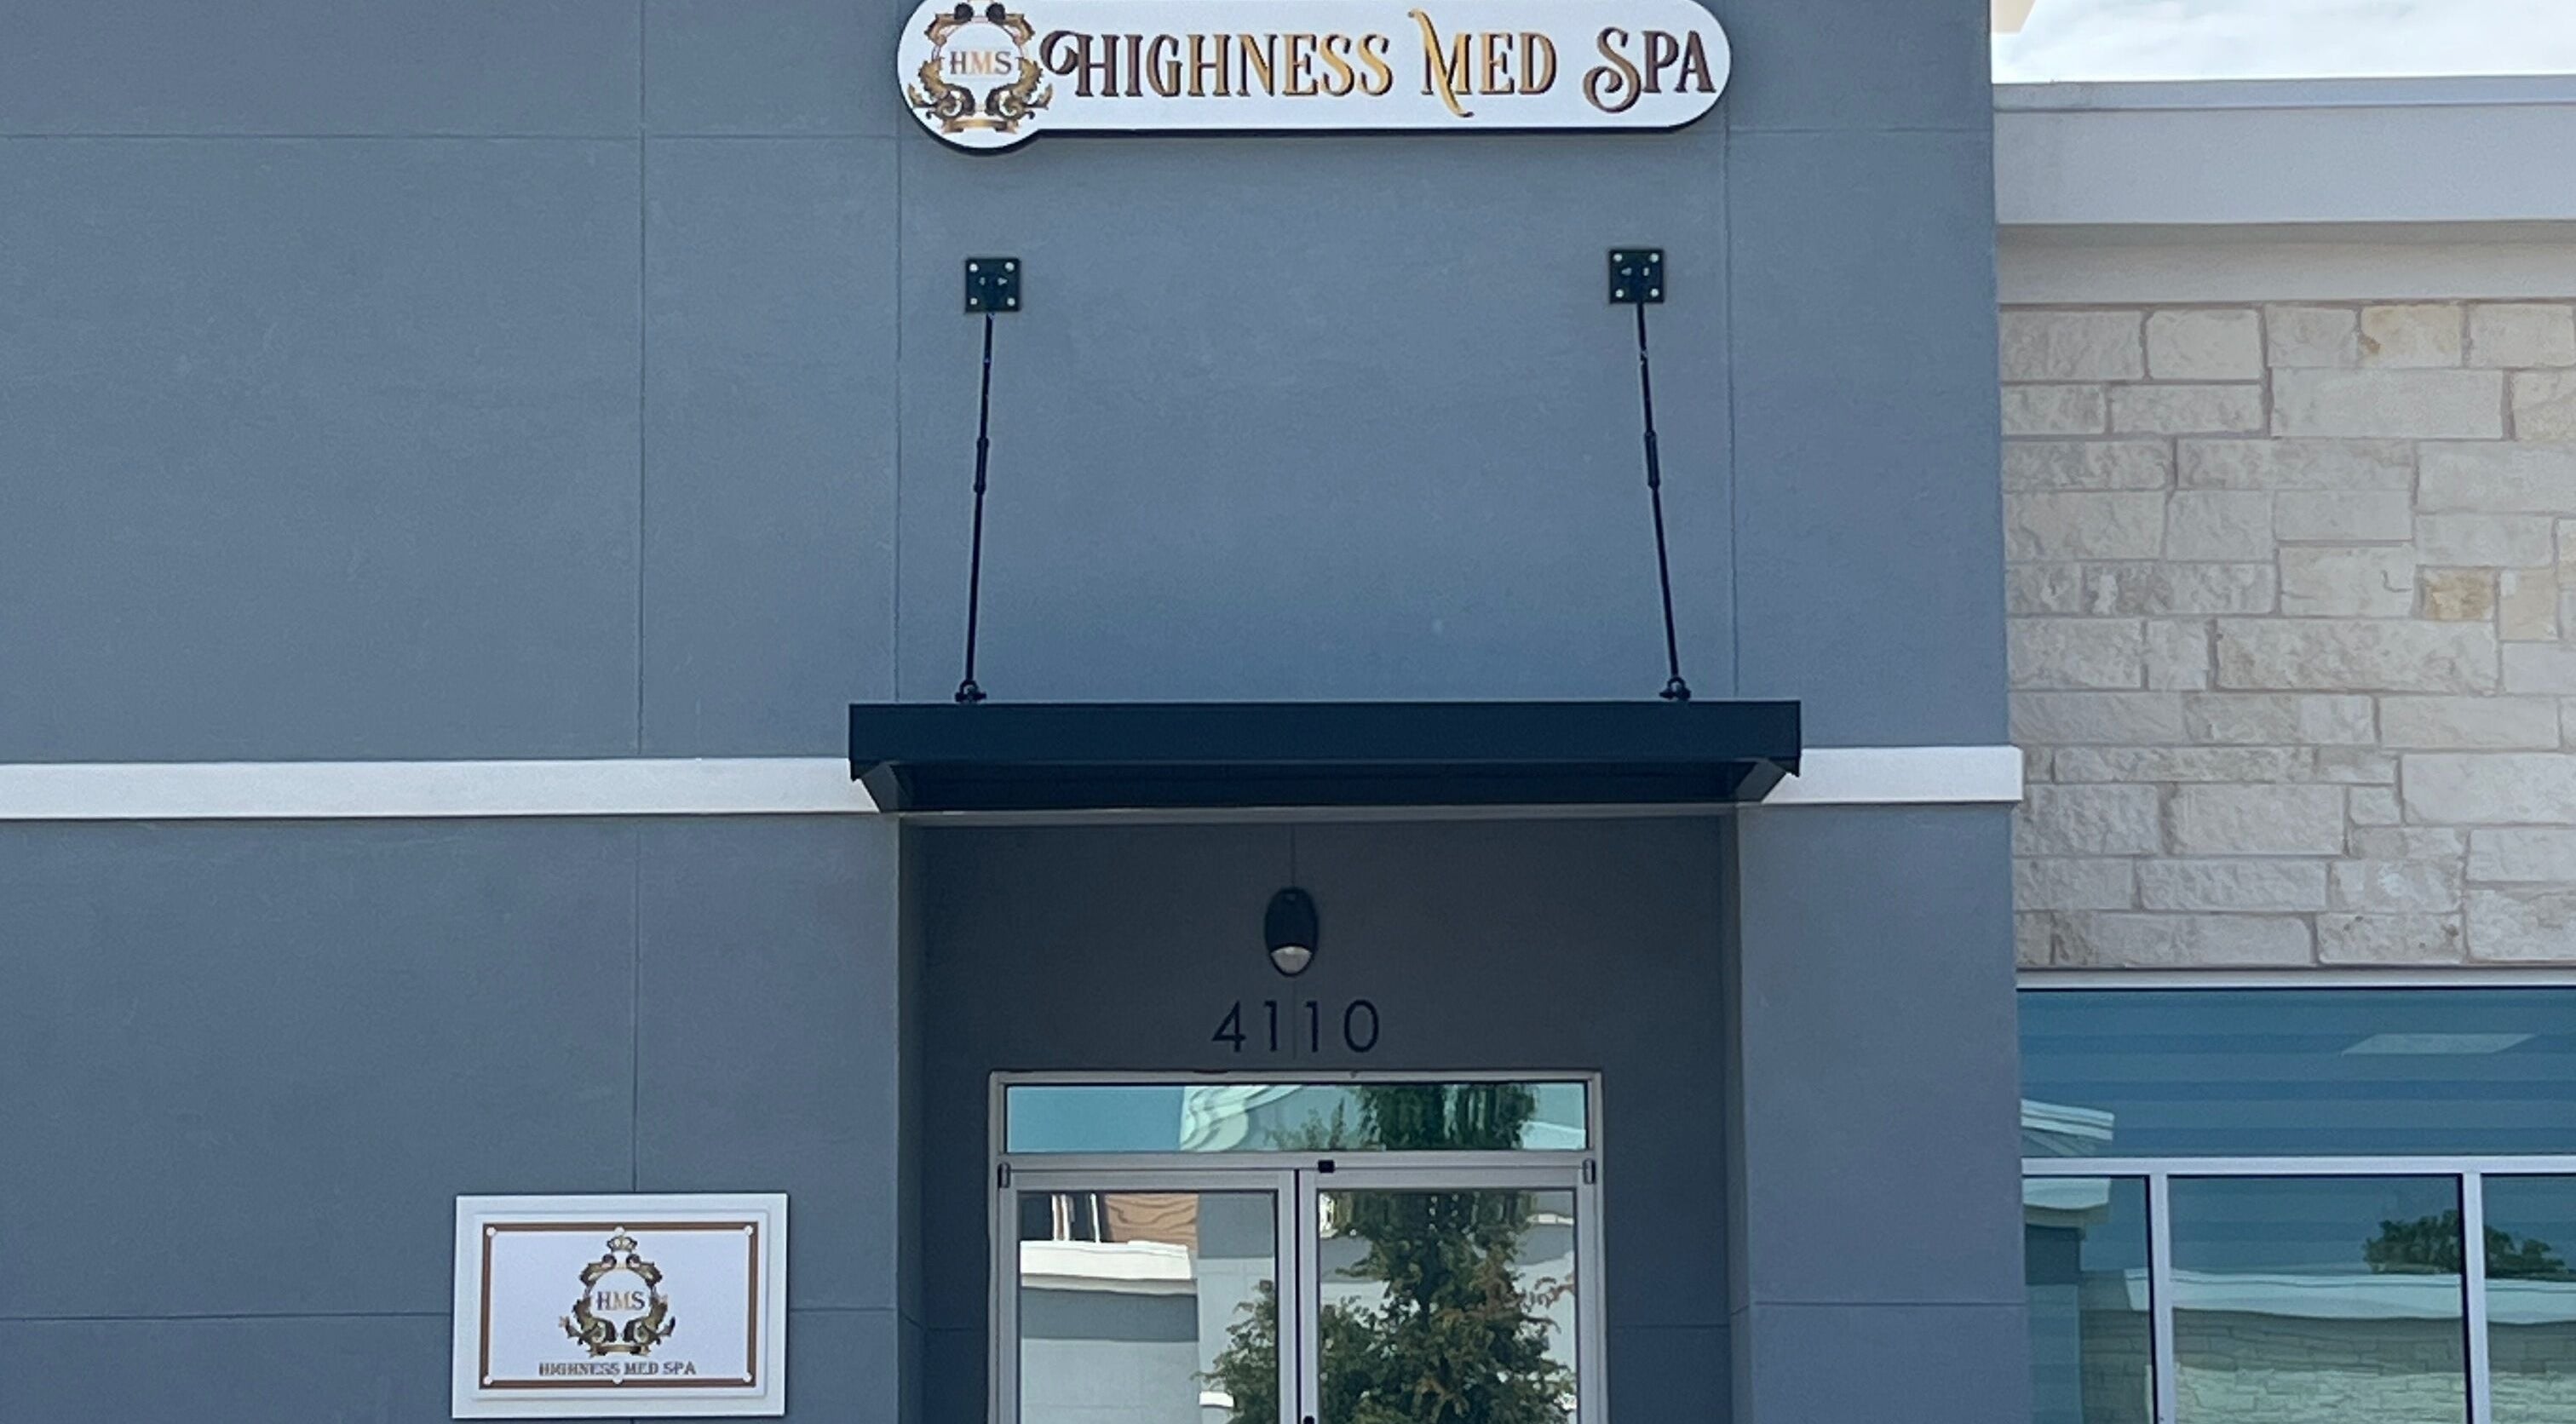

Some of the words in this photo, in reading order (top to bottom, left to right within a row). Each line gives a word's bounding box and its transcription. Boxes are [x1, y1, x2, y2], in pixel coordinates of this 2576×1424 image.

[949, 50, 1012, 76] HMS
[1039, 30, 1393, 98] HIGHNESS
[1408, 8, 1557, 118] MED
[1583, 26, 1716, 113] SPA
[1211, 999, 1379, 1054] 4110
[597, 1291, 645, 1311] HMS
[538, 1363, 621, 1376] HIGHNESS
[624, 1362, 659, 1375] MED
[663, 1361, 697, 1375] SPA
